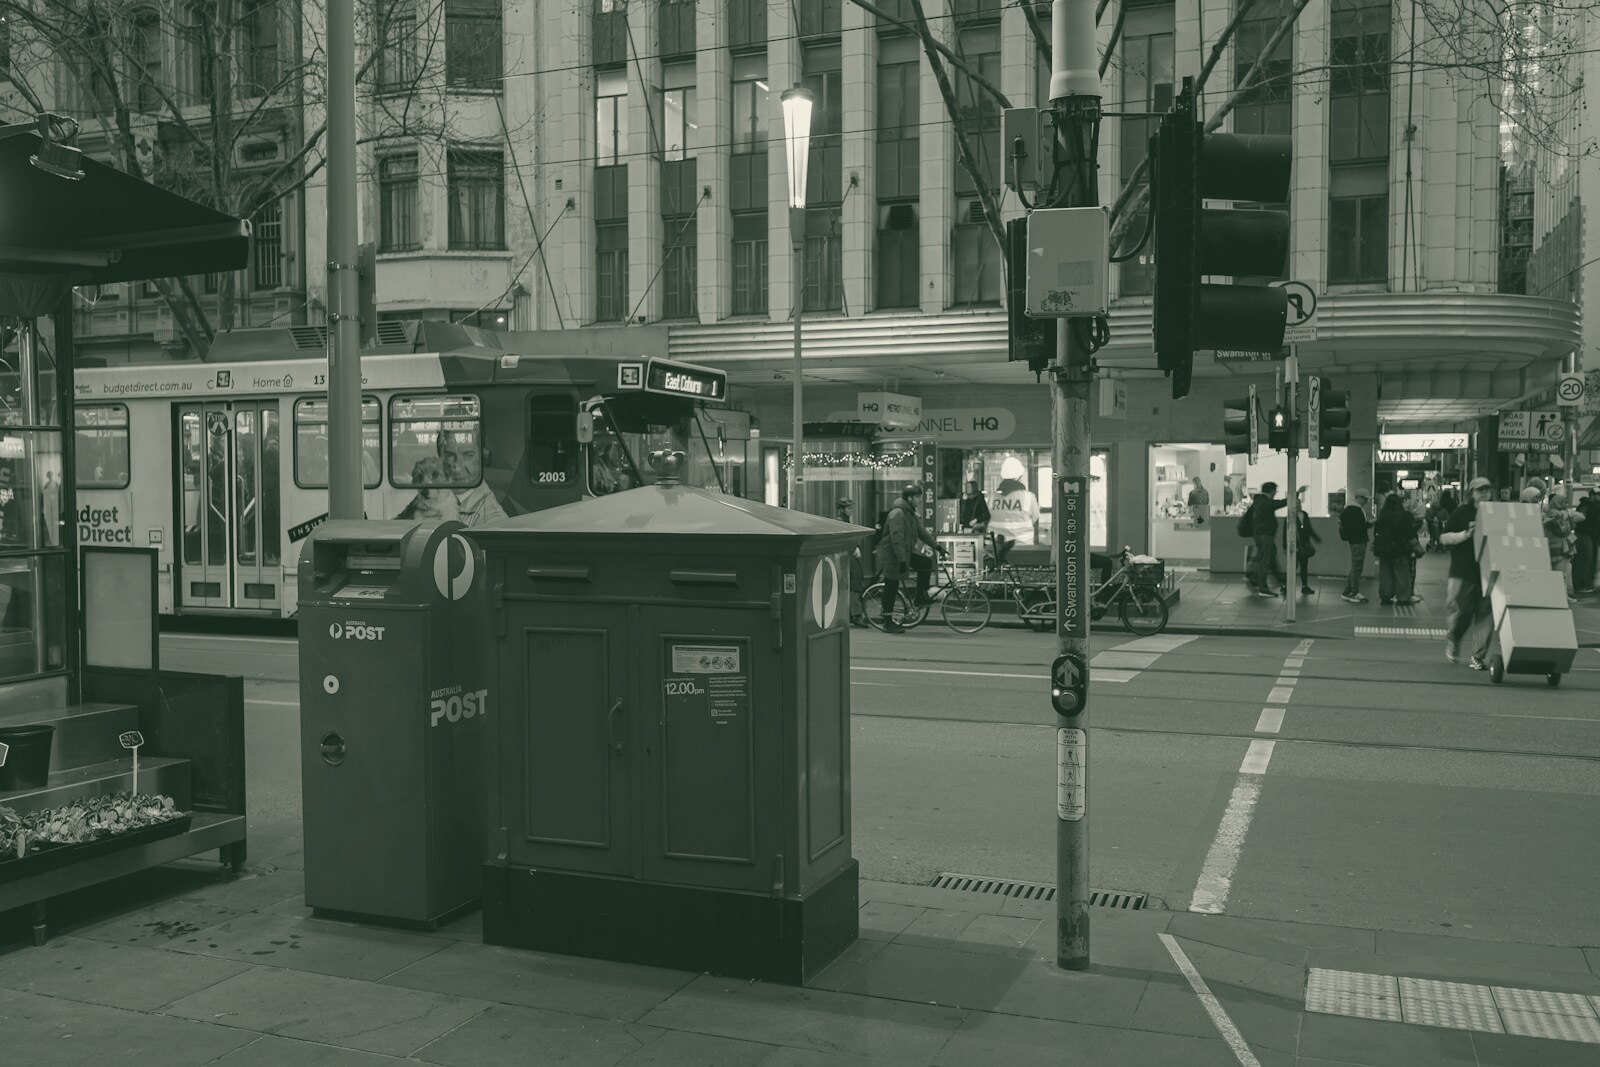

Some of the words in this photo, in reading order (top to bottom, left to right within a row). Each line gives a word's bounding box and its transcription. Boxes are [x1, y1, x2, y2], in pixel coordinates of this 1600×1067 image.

[103, 381, 192, 394] budgetdirect.com.au
[252, 377, 281, 388] Home
[665, 372, 680, 391] East
[711, 380, 718, 396] 1
[1562, 383, 1581, 395] 20
[862, 403, 879, 412] HQ
[973, 416, 999, 431] HQ
[1503, 421, 1524, 429] WORK
[1498, 441, 1528, 450] PREPARE
[539, 471, 566, 483] 2003
[1067, 499, 1077, 511] 90
[76, 504, 119, 528] dget
[79, 524, 131, 543] Direct
[1067, 519, 1077, 534] 130
[1065, 539, 1077, 554] St
[1065, 556, 1077, 618] Swanston
[345, 625, 386, 641] POST
[430, 684, 463, 700] AUSTRALIA
[665, 682, 705, 696] 12.00pm
[430, 689, 488, 728] POST
